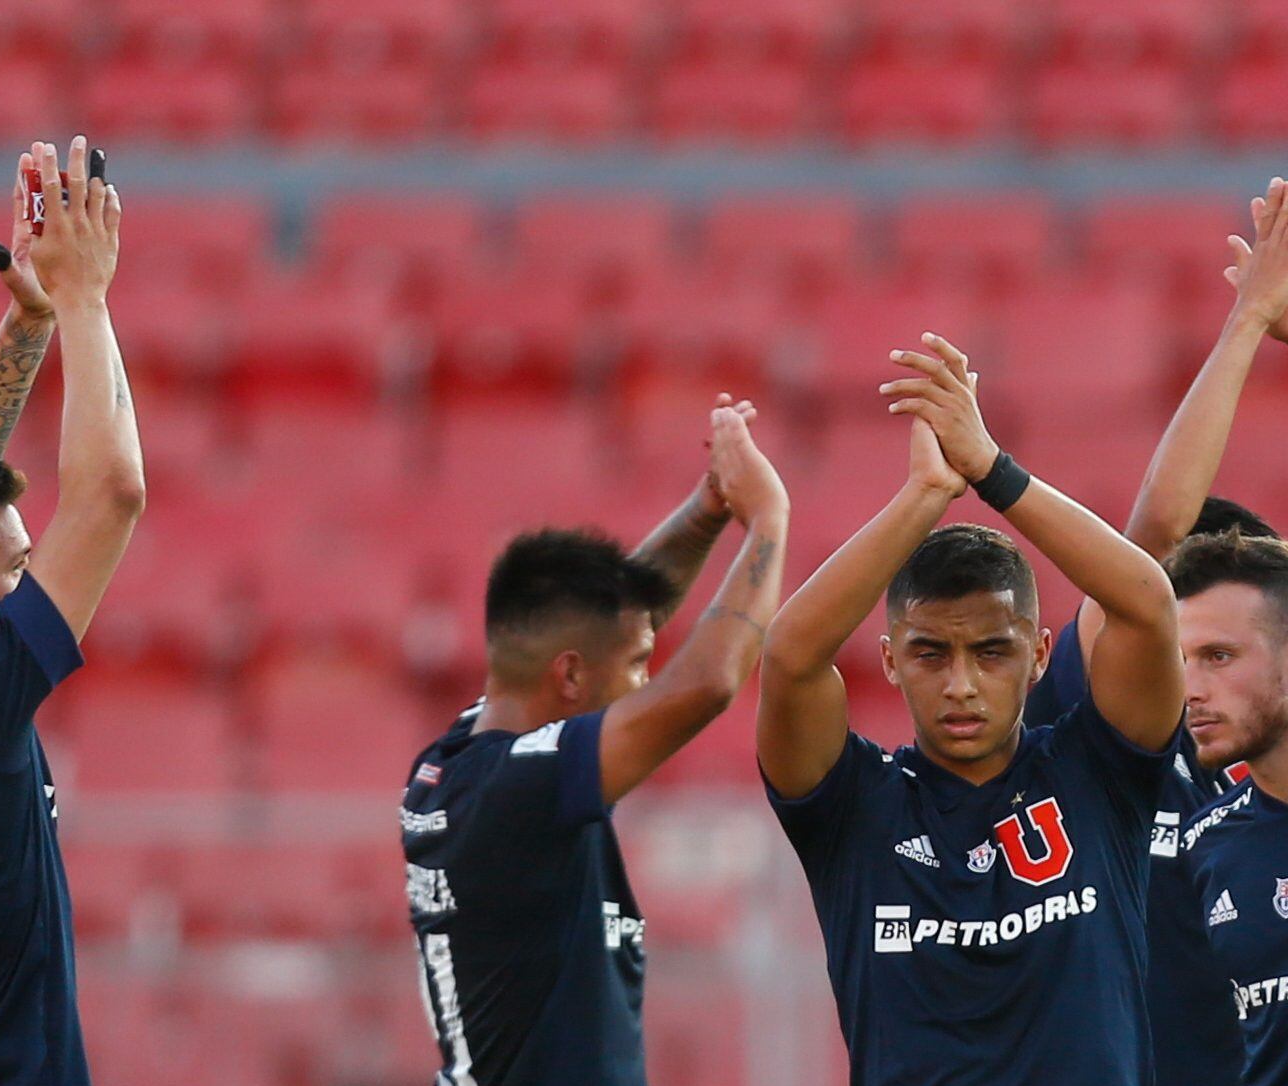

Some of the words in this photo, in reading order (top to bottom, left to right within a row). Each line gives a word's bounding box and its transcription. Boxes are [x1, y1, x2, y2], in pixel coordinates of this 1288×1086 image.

[894, 843, 941, 869] adidas
[993, 796, 1074, 887] U
[913, 886, 1098, 947] PETROBRAS
[1208, 909, 1239, 927] adidas
